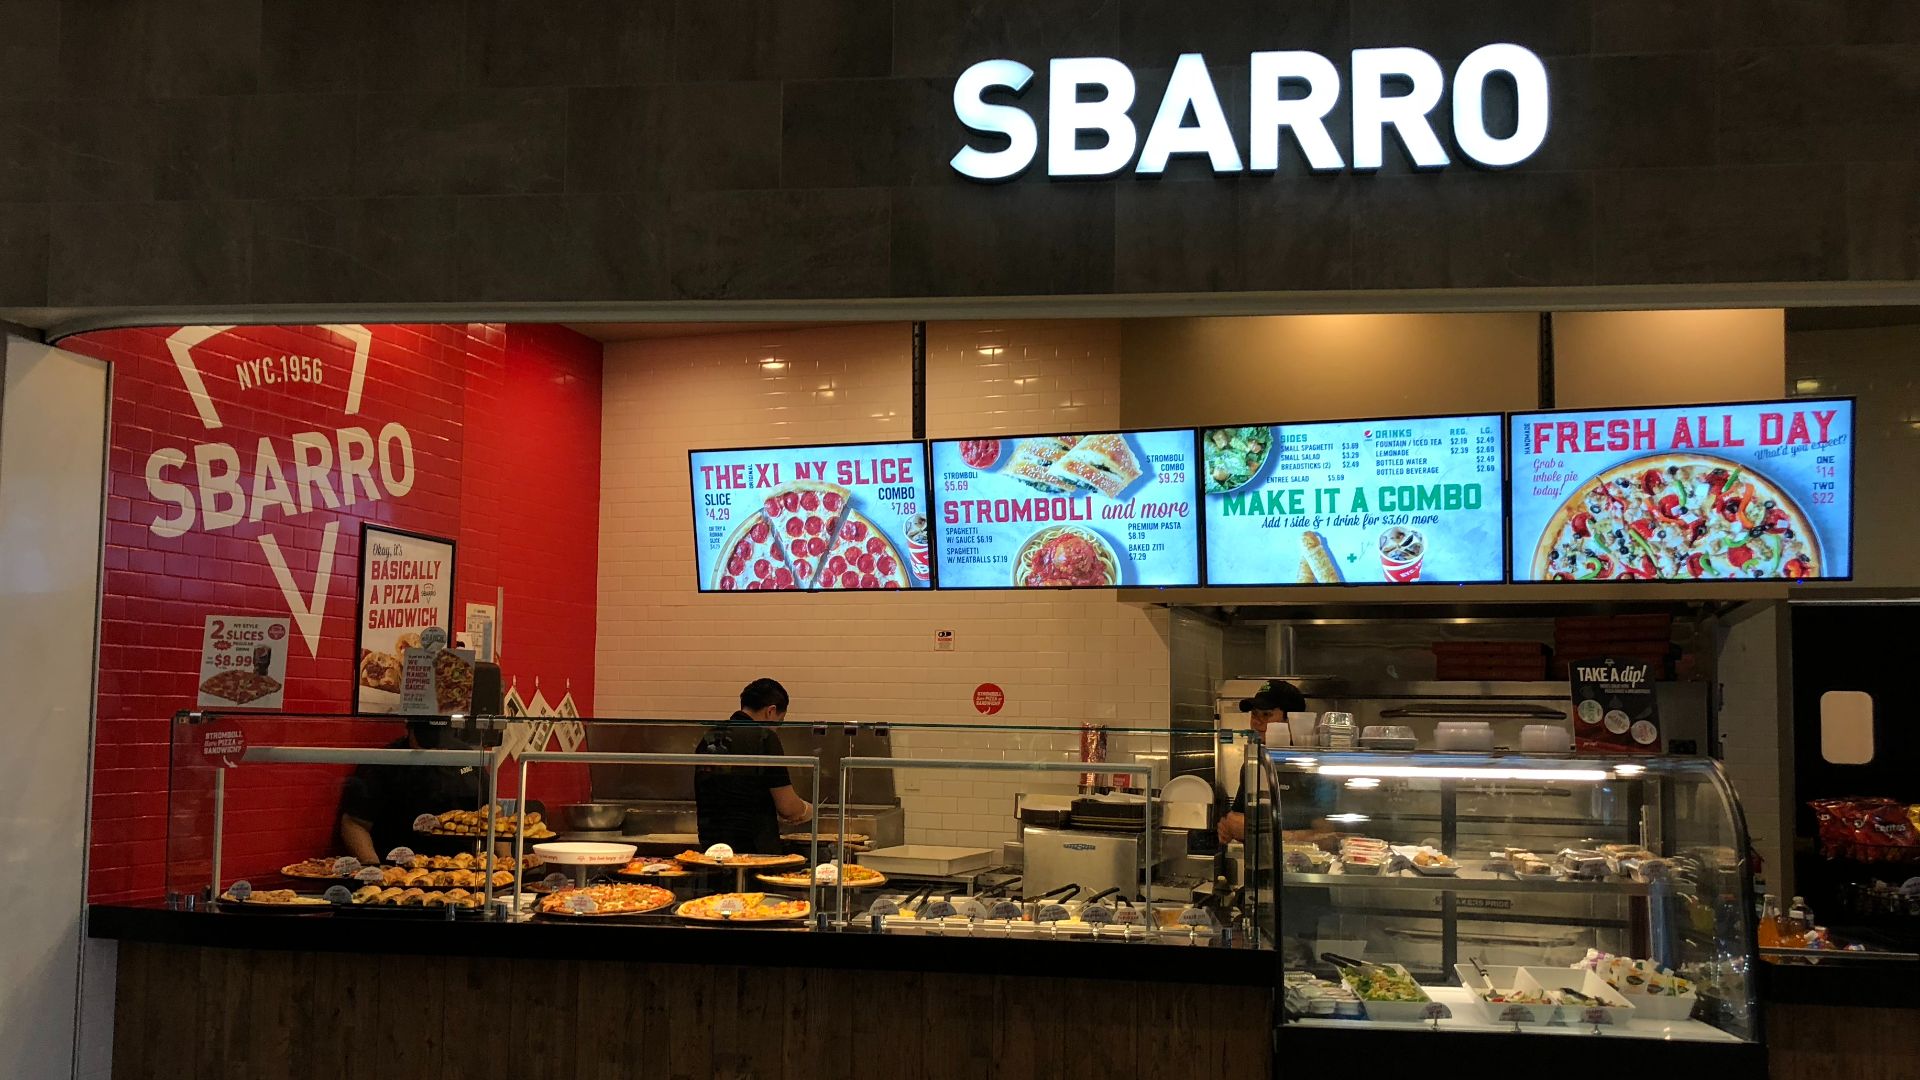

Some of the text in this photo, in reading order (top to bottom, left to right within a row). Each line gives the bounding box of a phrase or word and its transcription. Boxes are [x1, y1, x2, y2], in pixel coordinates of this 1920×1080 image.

[950, 43, 1549, 179] SBARRO
[236, 355, 323, 391] NYC.1956
[1375, 429, 1412, 439] DRINKS
[1533, 410, 1838, 454] FRESH ALL DAY
[1280, 434, 1308, 443] SIDES
[1375, 440, 1407, 448] FOUNTAIN
[1413, 439, 1429, 447] ICED
[1430, 438, 1442, 446] TEA
[1476, 436, 1495, 444] $2.49
[1280, 444, 1300, 452] SMALL
[1301, 443, 1334, 451] SPAGHETTI
[1754, 434, 1847, 460] What'd you expect?
[1146, 453, 1185, 463] STROMBOLI
[1280, 454, 1300, 462] SMALL
[1301, 453, 1321, 461] SALAD
[1375, 449, 1409, 458] LEMONADE
[1376, 458, 1404, 467] BOTTLED
[1406, 457, 1428, 466] WATER
[1533, 458, 1556, 472] Grab
[1816, 456, 1835, 464] ONE
[795, 460, 827, 480] NY
[837, 458, 913, 485] SLICE
[1160, 463, 1185, 472] COMBO
[1281, 462, 1321, 471] BREADSTICKS
[1376, 467, 1404, 476] BOTTLED
[1406, 466, 1440, 474] BEVERAGE
[1816, 465, 1835, 477] $14
[145, 422, 415, 538] SBARRO
[700, 464, 746, 490] THE
[943, 471, 978, 480] STROMBOLI
[1158, 472, 1185, 484] $9.29
[1267, 476, 1289, 484] ENTREE
[1290, 475, 1310, 483] SALAD
[1533, 471, 1563, 483] whole
[944, 480, 969, 492] $5.69
[1533, 484, 1563, 498] today!
[1813, 482, 1834, 490] TWO
[704, 493, 732, 506] SLICE
[878, 487, 915, 500] COMBO
[1812, 492, 1834, 504] $22
[1222, 483, 1482, 517] MAKE IT A COMBO
[891, 501, 916, 515] $7.89
[943, 496, 1190, 524] STROMBOLI and more
[706, 508, 730, 521] $4.29
[1128, 521, 1182, 531] PREMIUM PASTA
[1261, 516, 1281, 529] Add
[1290, 515, 1310, 528] side
[1312, 516, 1325, 529] &
[1333, 514, 1360, 527] drink
[1362, 513, 1380, 530] for
[1382, 513, 1409, 526] $3.60
[1411, 514, 1439, 525] more
[945, 527, 978, 535] SPAGHETTI
[955, 535, 975, 544] SAUCE
[946, 547, 979, 555] SPAGHETTI
[1128, 543, 1165, 552] BAKED ZITI
[956, 555, 991, 564] MEATBALLS
[1129, 552, 1147, 561] $7.29
[371, 560, 442, 580] BASICALLY
[369, 583, 420, 605] A PIZZA
[368, 607, 438, 630] SANDWICH
[210, 620, 225, 640] 2
[226, 630, 264, 641] SLICES
[214, 653, 252, 668] $8.99
[1577, 664, 1647, 688] TAKE A dip!
[217, 738, 236, 747] PIZZA
[1456, 898, 1484, 907] AKERS
